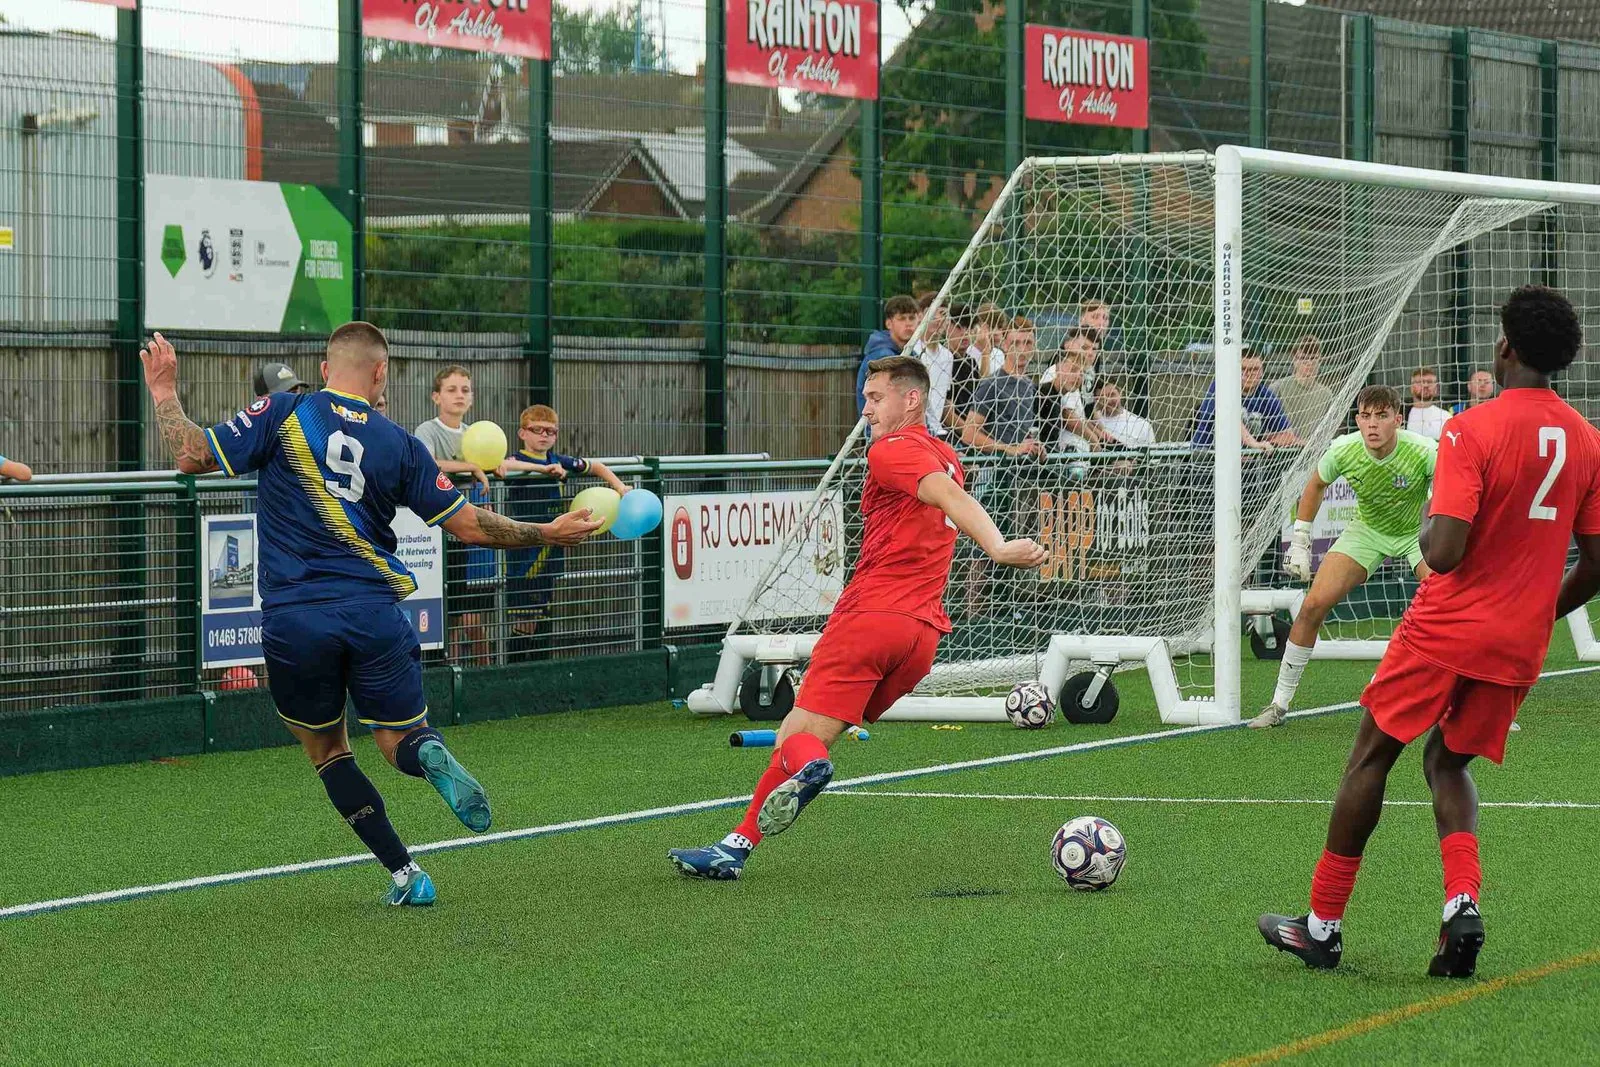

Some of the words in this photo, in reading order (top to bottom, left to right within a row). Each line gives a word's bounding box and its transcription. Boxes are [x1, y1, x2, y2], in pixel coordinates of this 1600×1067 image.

[414, 2, 440, 40] Of
[445, 7, 504, 49] Ashby
[748, 0, 861, 57] RAINTON
[768, 50, 788, 84] Of
[793, 54, 841, 90] Ashby
[1042, 32, 1134, 90] RAINTON
[1058, 87, 1075, 120] Of
[1079, 90, 1118, 122] Ashby
[1222, 299, 1231, 336] SPORT
[324, 430, 366, 503] 9
[1528, 426, 1567, 521] 2
[397, 534, 431, 544] tribution
[701, 504, 721, 549] RJ
[404, 558, 433, 570] housing
[405, 546, 437, 556] Network
[700, 558, 778, 582] ELECTRIC
[208, 628, 236, 648] 01469
